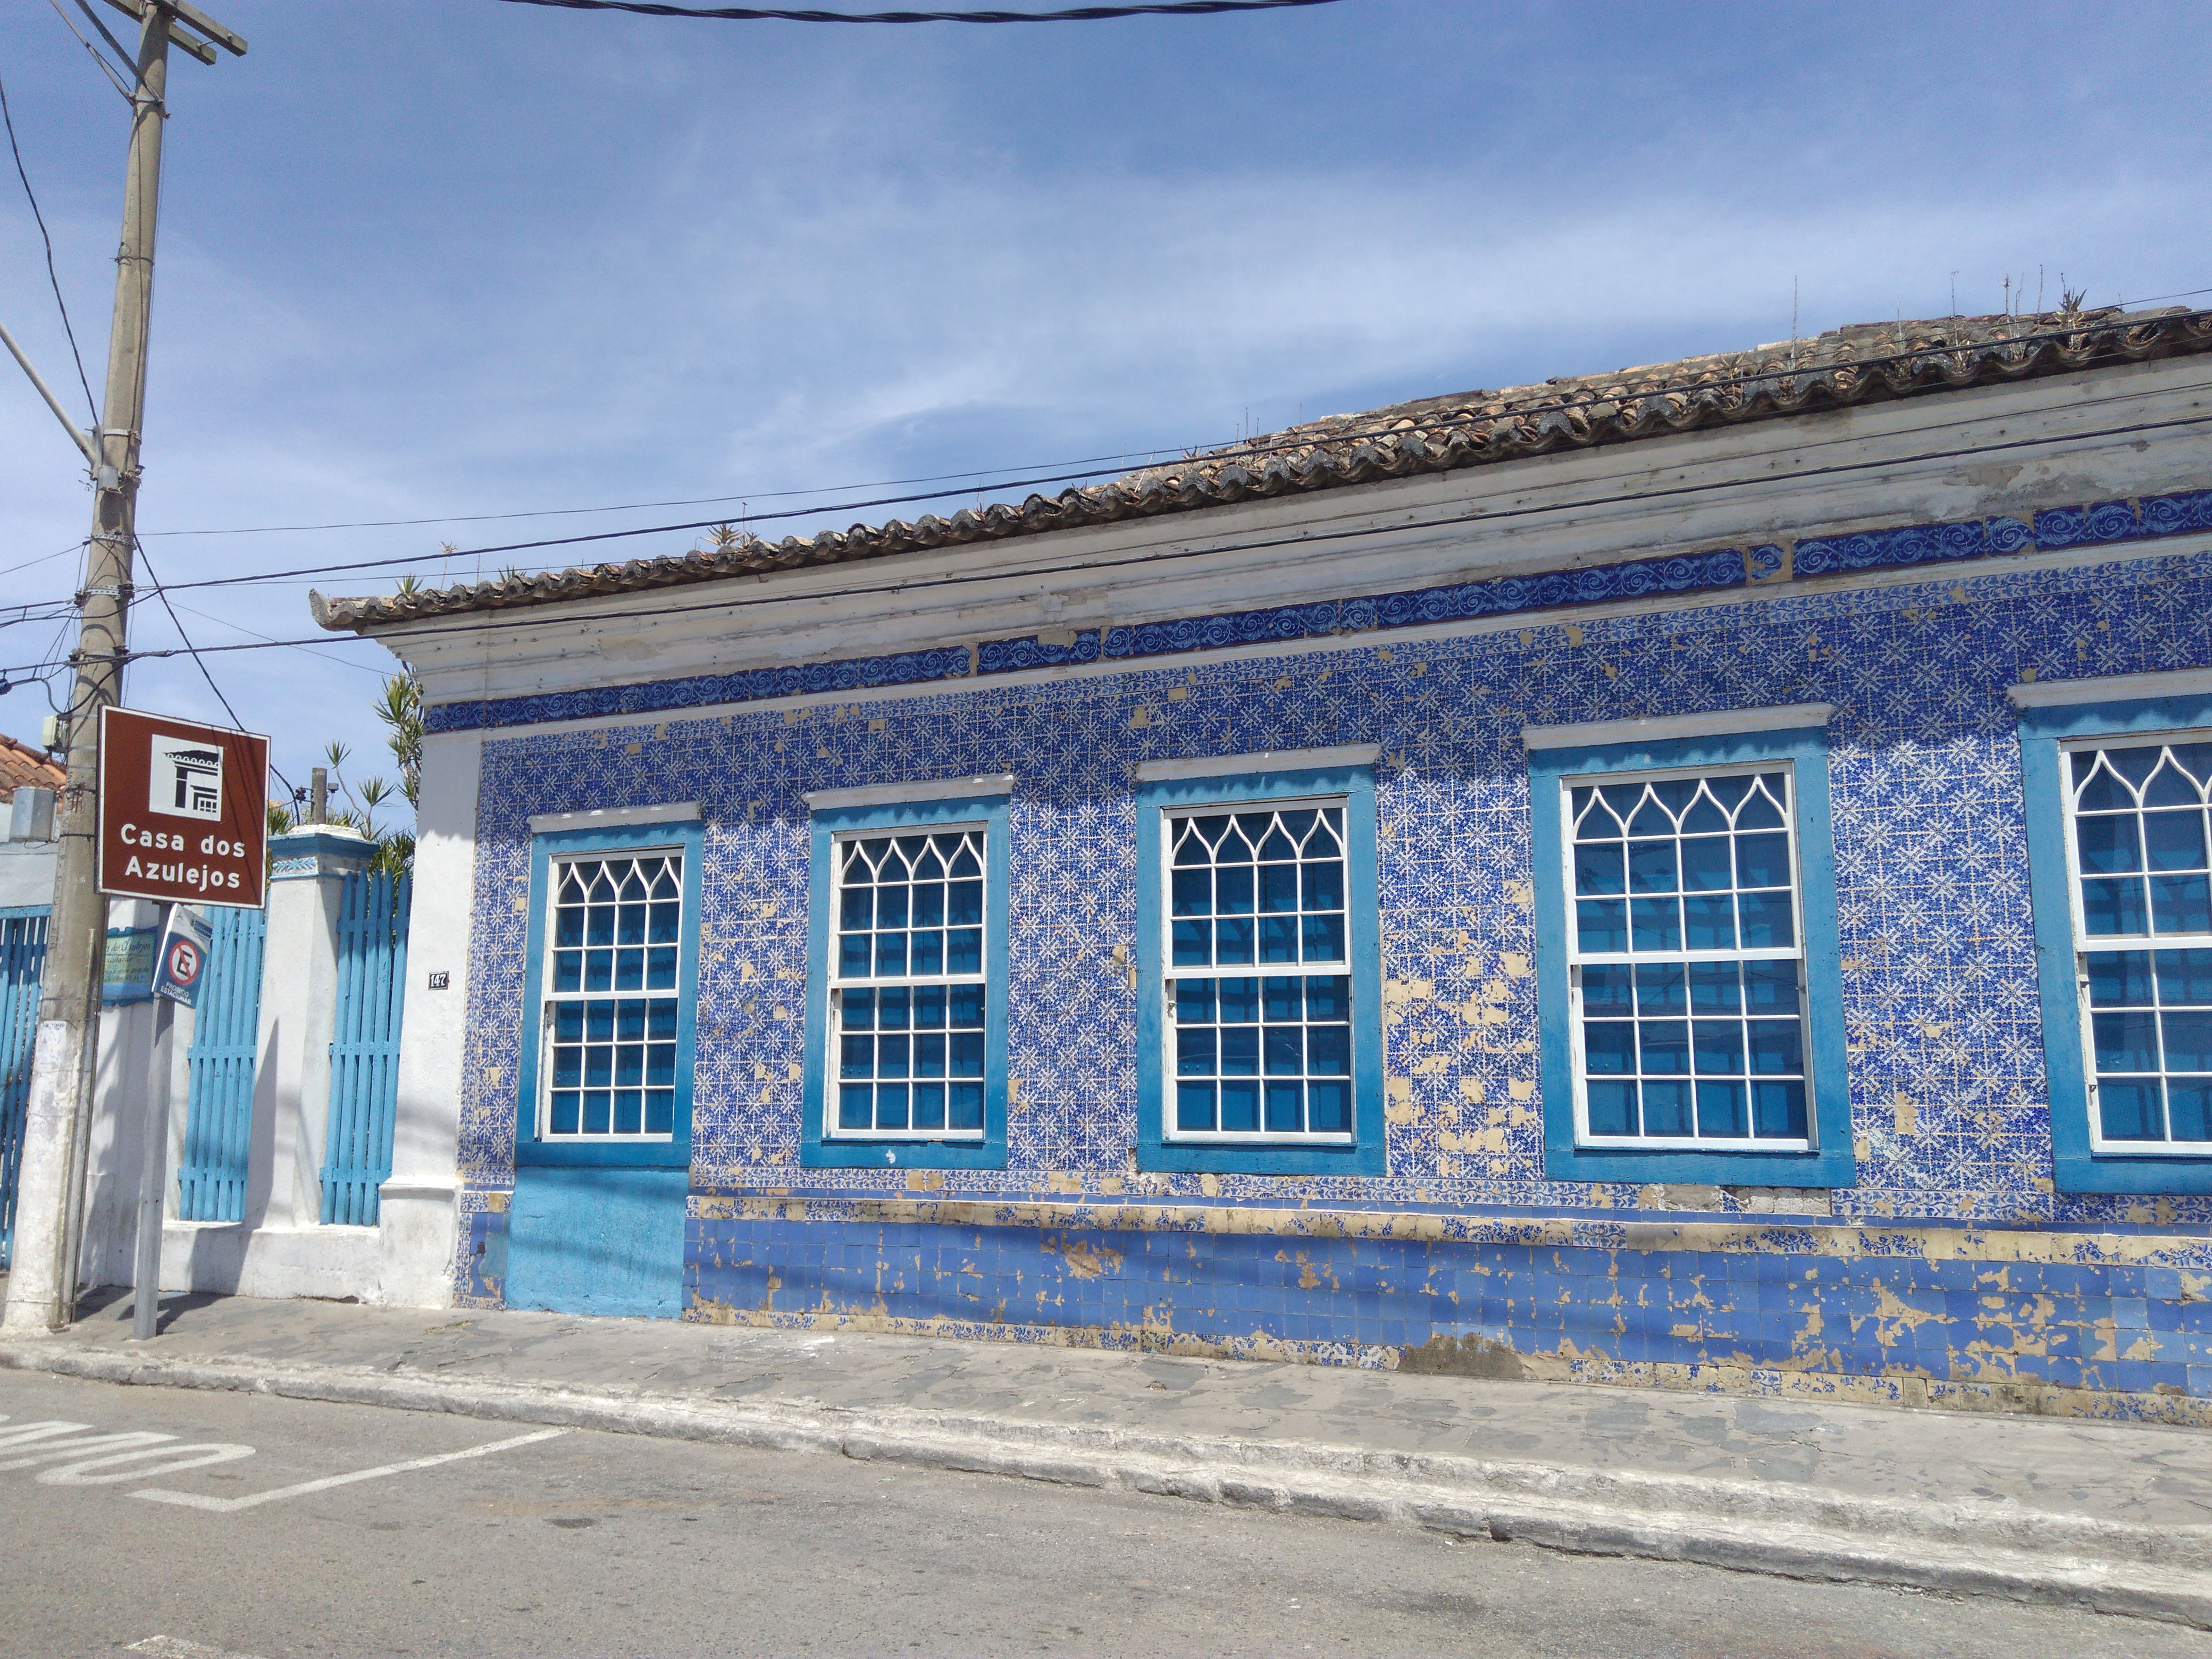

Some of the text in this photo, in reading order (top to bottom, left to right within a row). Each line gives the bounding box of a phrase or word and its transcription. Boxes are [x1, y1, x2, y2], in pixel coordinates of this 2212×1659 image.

[121, 823, 246, 858] Casa dos
[124, 855, 240, 892] Azulejos
[166, 981, 189, 998] PROIBIDO
[430, 974, 447, 987] 147
[160, 985, 192, 1006] ESTACIONAR
